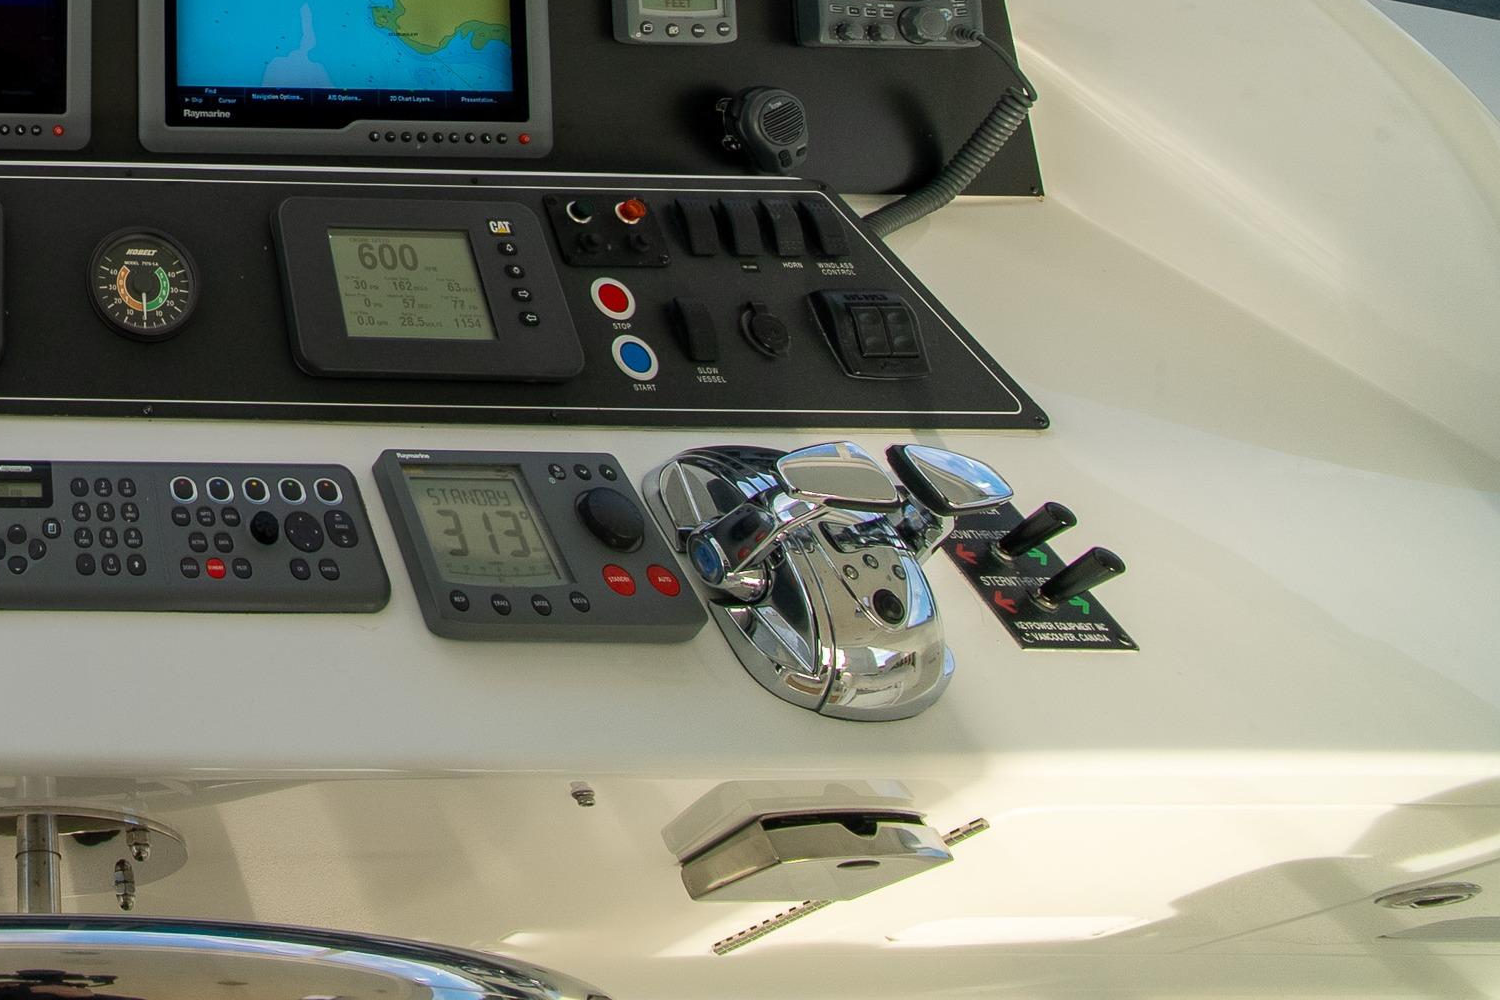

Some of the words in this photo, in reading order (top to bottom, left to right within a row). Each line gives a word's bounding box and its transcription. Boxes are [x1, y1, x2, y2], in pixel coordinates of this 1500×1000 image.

[665, 0, 692, 8] FEET
[183, 109, 231, 119] Raymarine
[489, 220, 511, 234] CAT
[357, 242, 419, 271] 600
[354, 280, 367, 290] 30
[392, 281, 413, 291] 162
[357, 315, 375, 326] 0.0
[399, 316, 425, 327] 28.5
[612, 322, 632, 330] STOP
[696, 375, 728, 383] VESSEL
[632, 384, 657, 392] START
[426, 488, 511, 506] STANDBY
[1014, 621, 1056, 630] KEYPOWER
[1054, 622, 1095, 631] EQUIPMENT
[1078, 633, 1111, 642] CANADA
